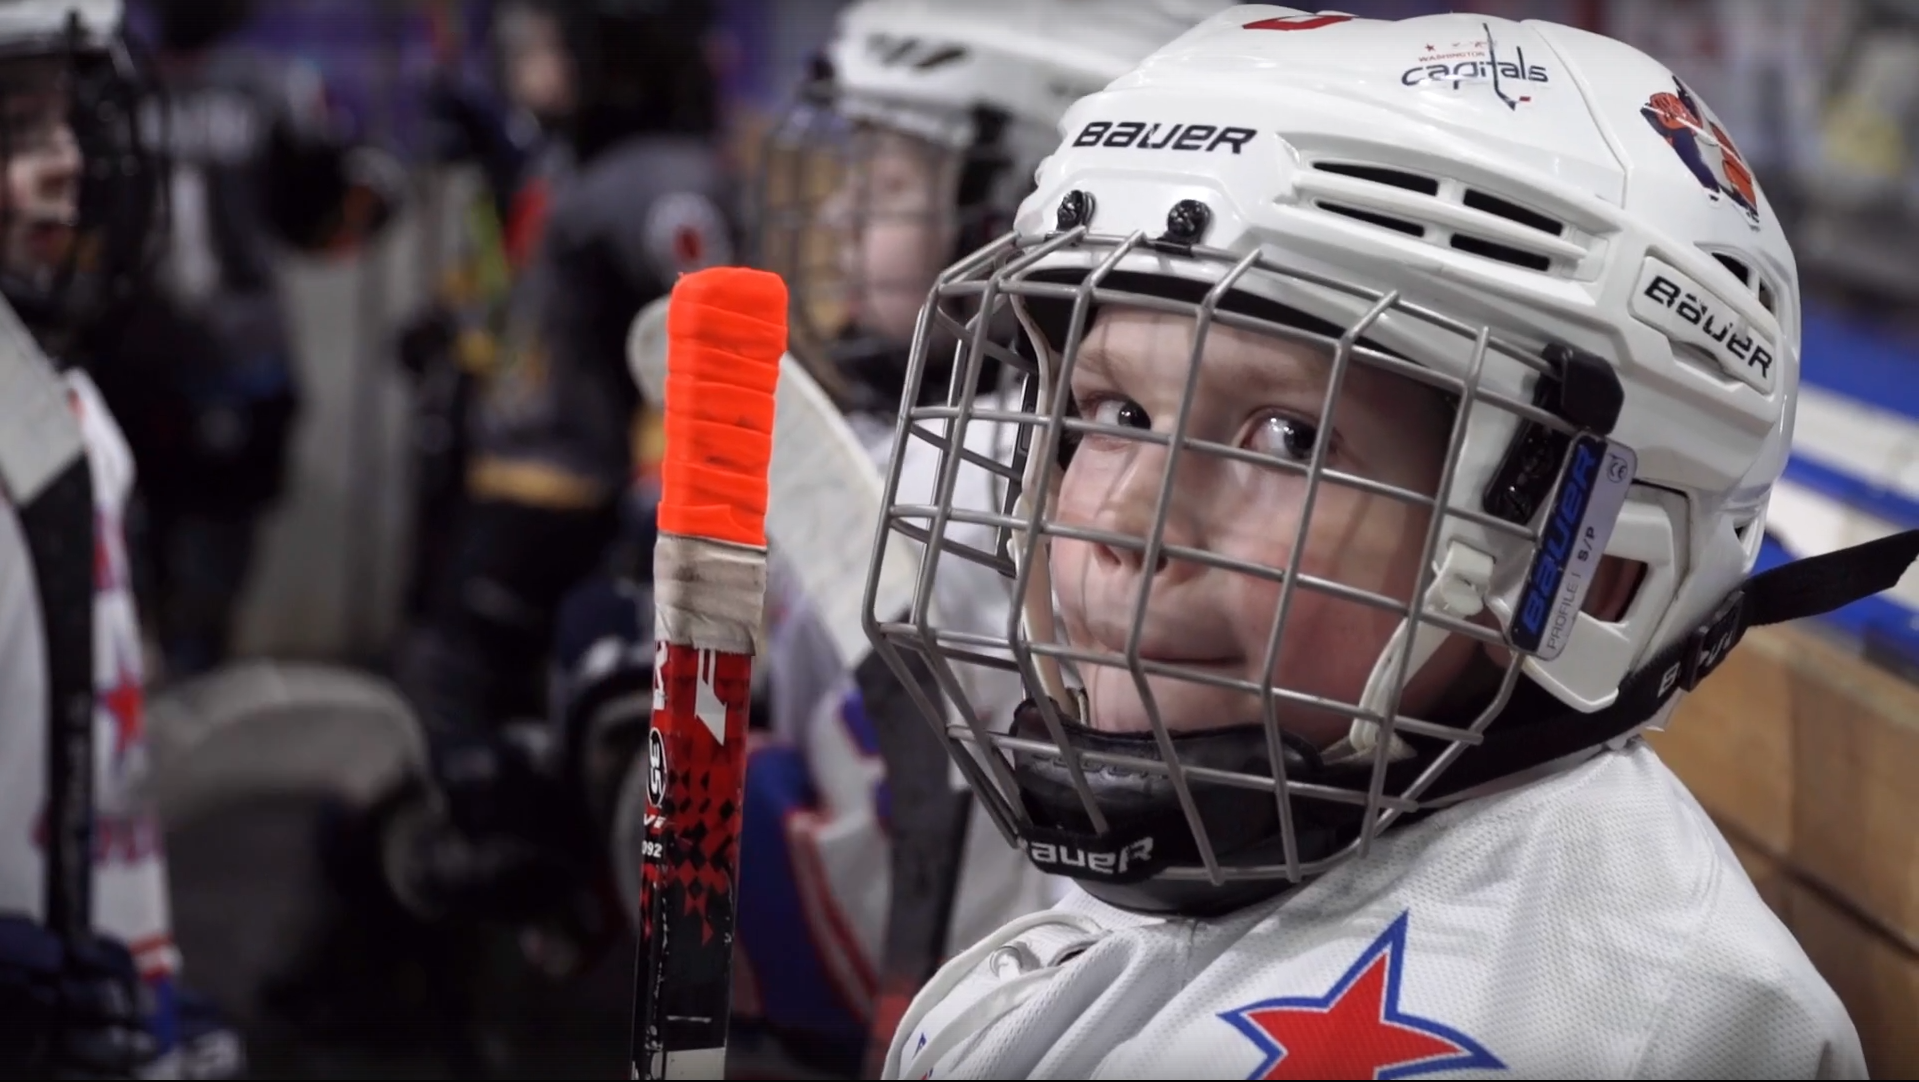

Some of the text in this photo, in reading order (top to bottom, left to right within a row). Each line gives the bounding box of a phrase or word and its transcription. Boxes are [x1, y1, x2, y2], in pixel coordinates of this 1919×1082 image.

[1418, 51, 1485, 62] WASHINGTON
[1072, 121, 1258, 155] BAUER
[1644, 275, 1773, 379] BAUER
[1522, 443, 1597, 635] BAUER
[1577, 526, 1596, 562] S/P
